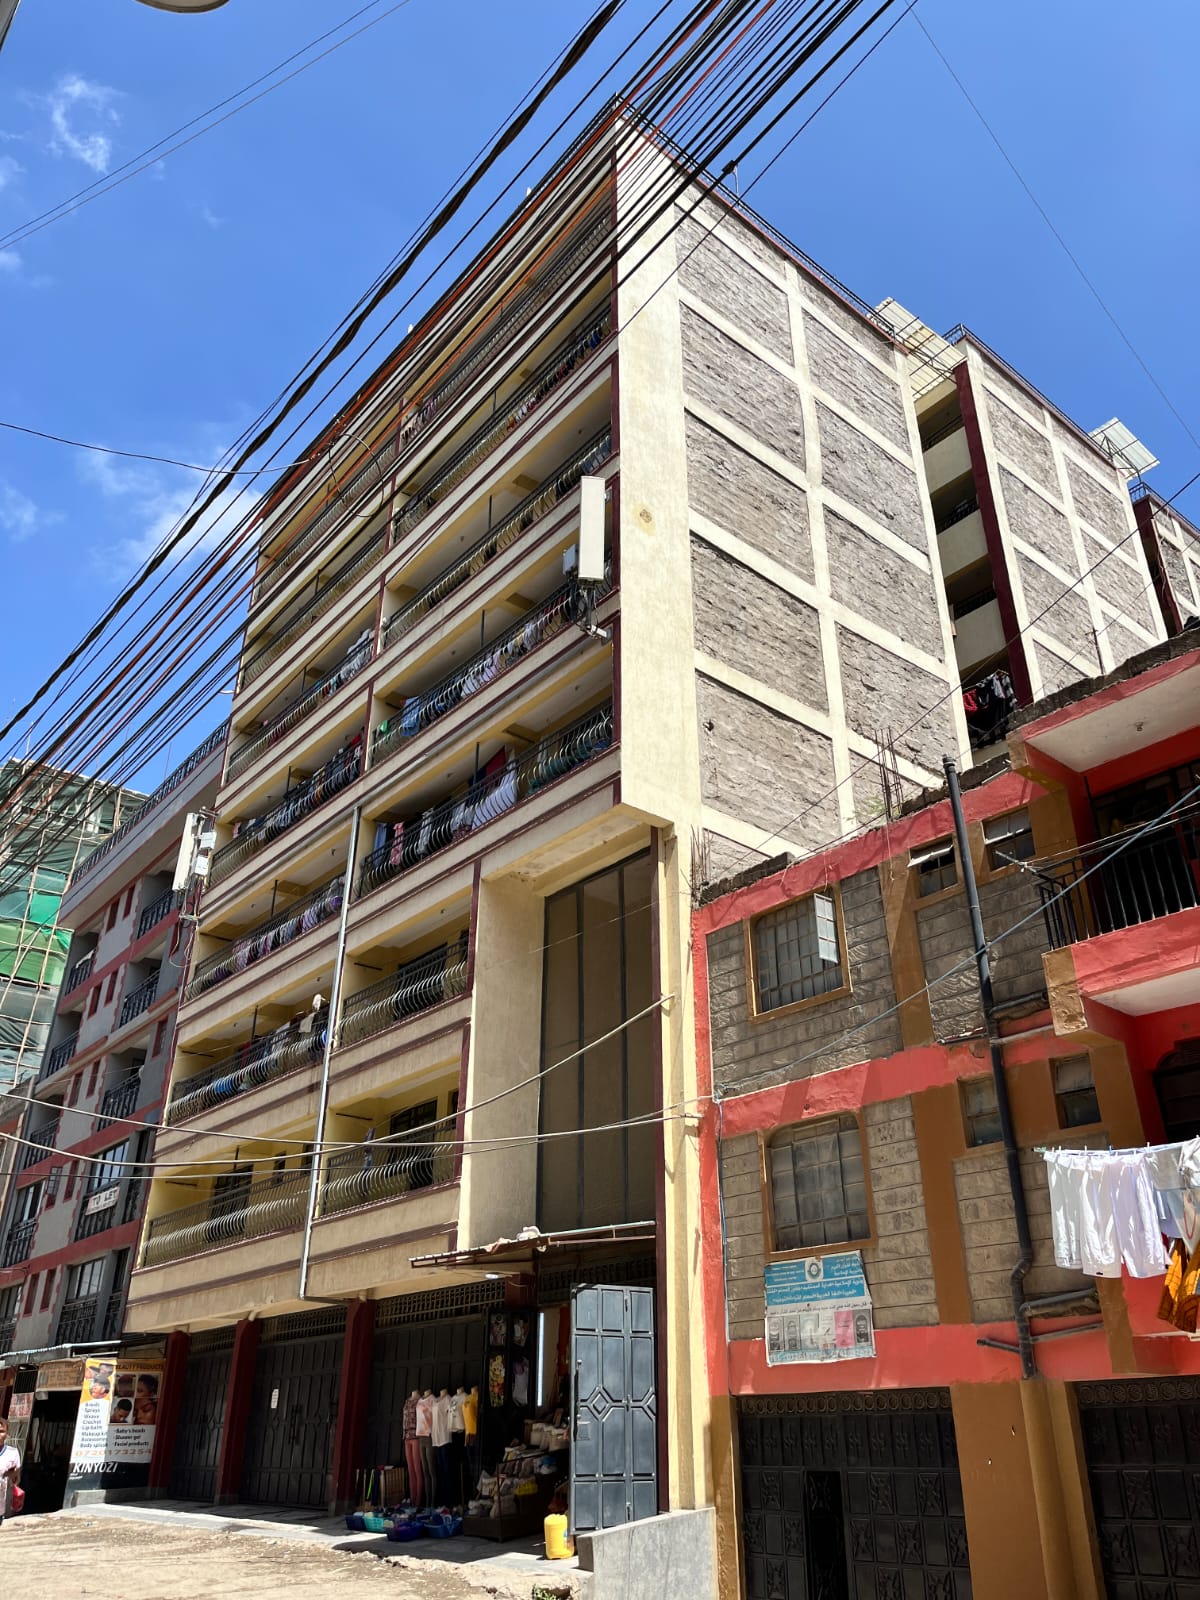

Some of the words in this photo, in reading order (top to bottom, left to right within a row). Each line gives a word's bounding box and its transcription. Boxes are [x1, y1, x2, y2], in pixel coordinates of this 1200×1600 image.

[92, 1195, 101, 1205] TO
[104, 1189, 118, 1202] LET
[72, 1462, 119, 1473] KINYOZI
